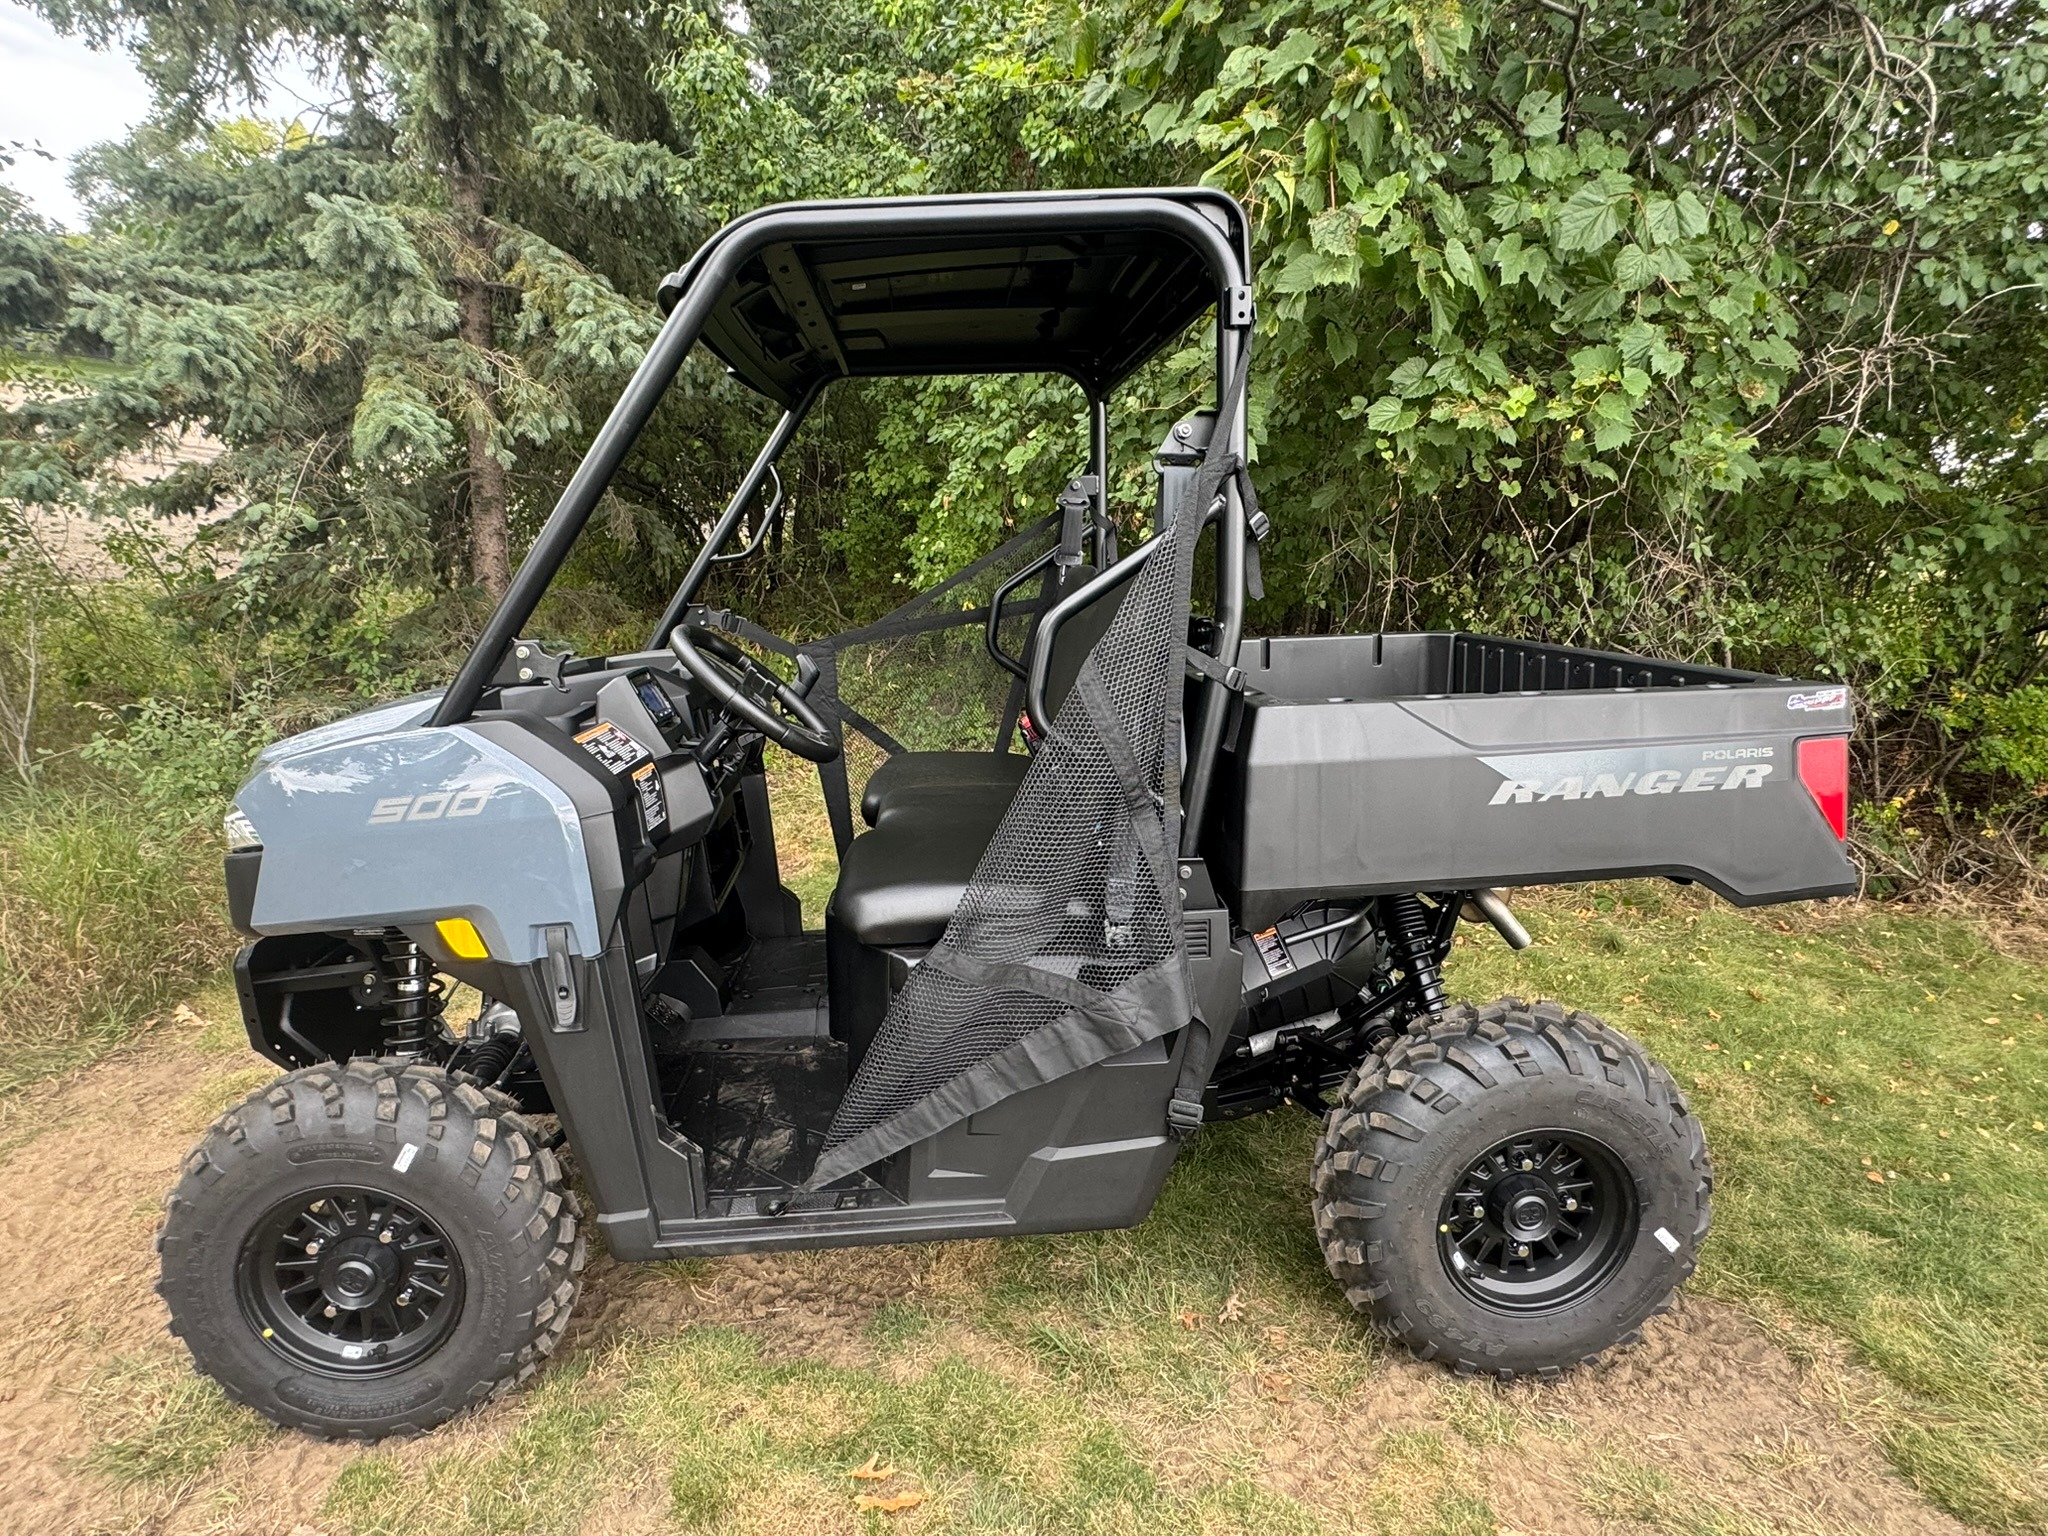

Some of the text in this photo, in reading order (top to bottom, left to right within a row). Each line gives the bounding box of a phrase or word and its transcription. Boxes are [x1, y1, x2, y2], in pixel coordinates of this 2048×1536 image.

[1702, 746, 1774, 761] POLARIS
[1488, 763, 1773, 805] RANGER
[367, 790, 491, 824] 500
